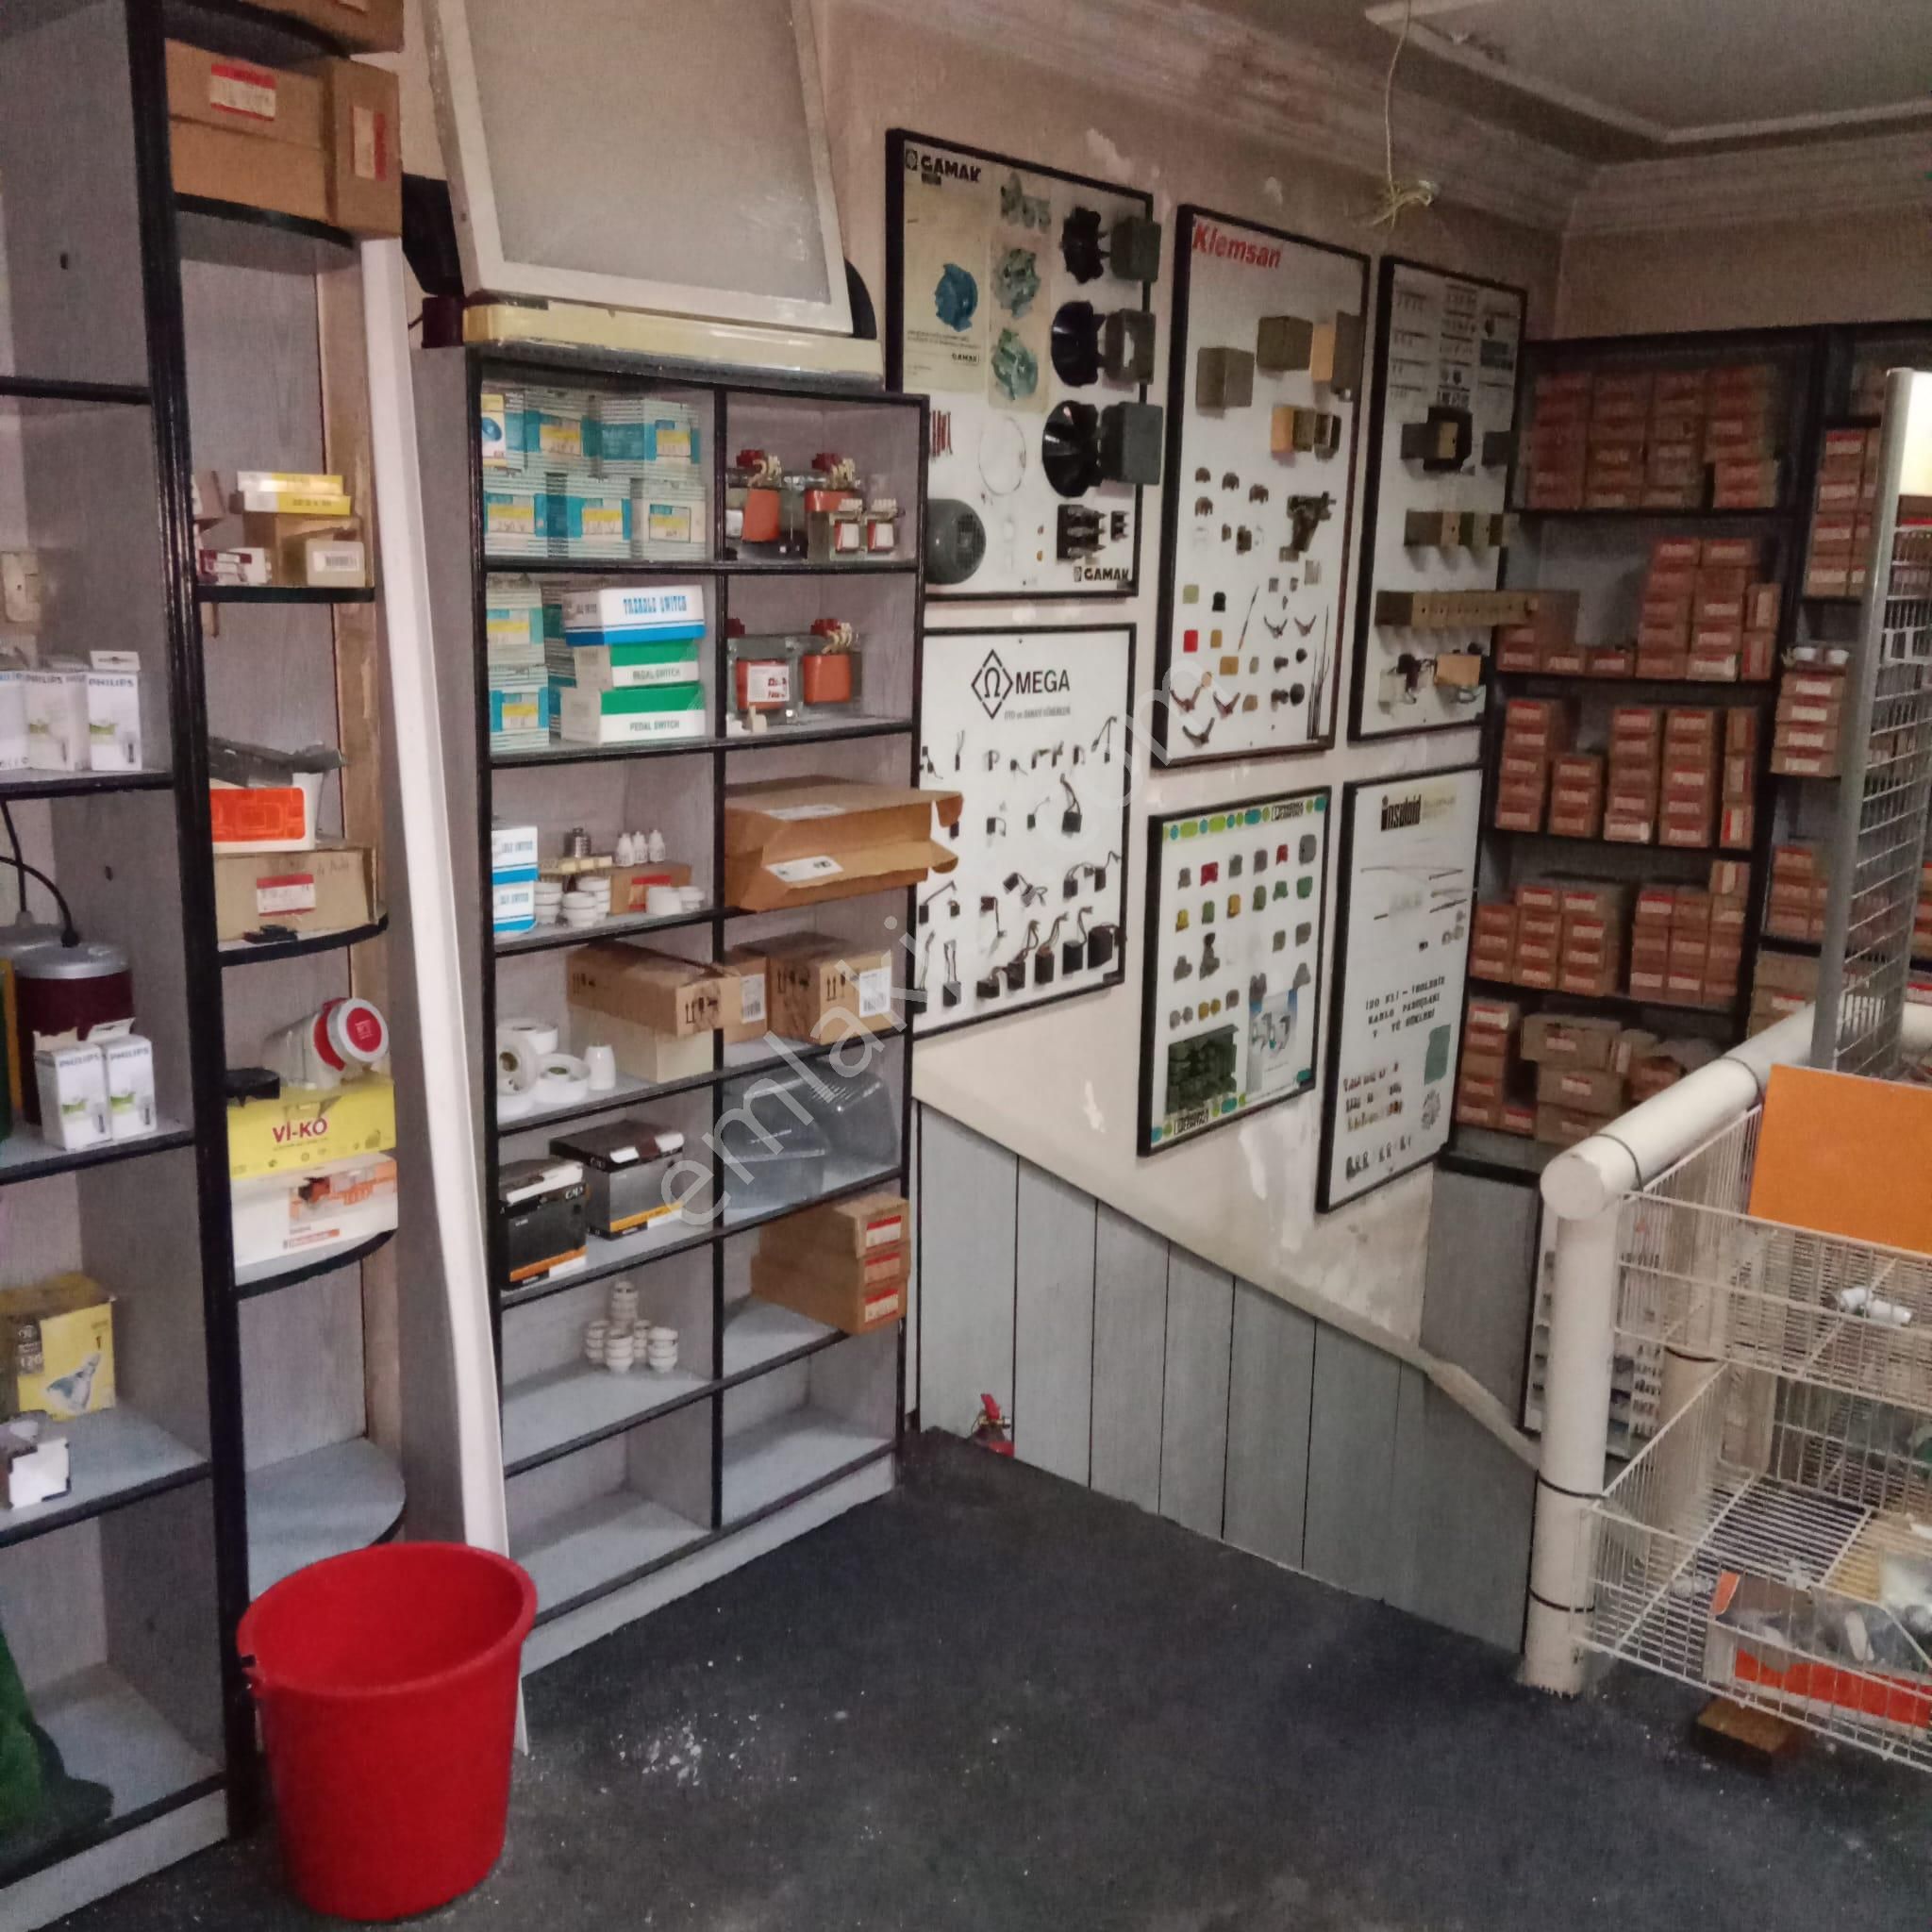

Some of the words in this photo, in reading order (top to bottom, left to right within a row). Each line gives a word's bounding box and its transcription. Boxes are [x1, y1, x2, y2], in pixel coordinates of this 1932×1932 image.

[921, 155, 981, 183] GAMAK
[1191, 224, 1281, 268] Klemsan
[1084, 568, 1129, 581] GAMAK
[89, 678, 134, 687] PHILIPS
[629, 722, 652, 731] PEDAL
[654, 720, 679, 730] SWITCH
[110, 1047, 150, 1060] PHILIPS
